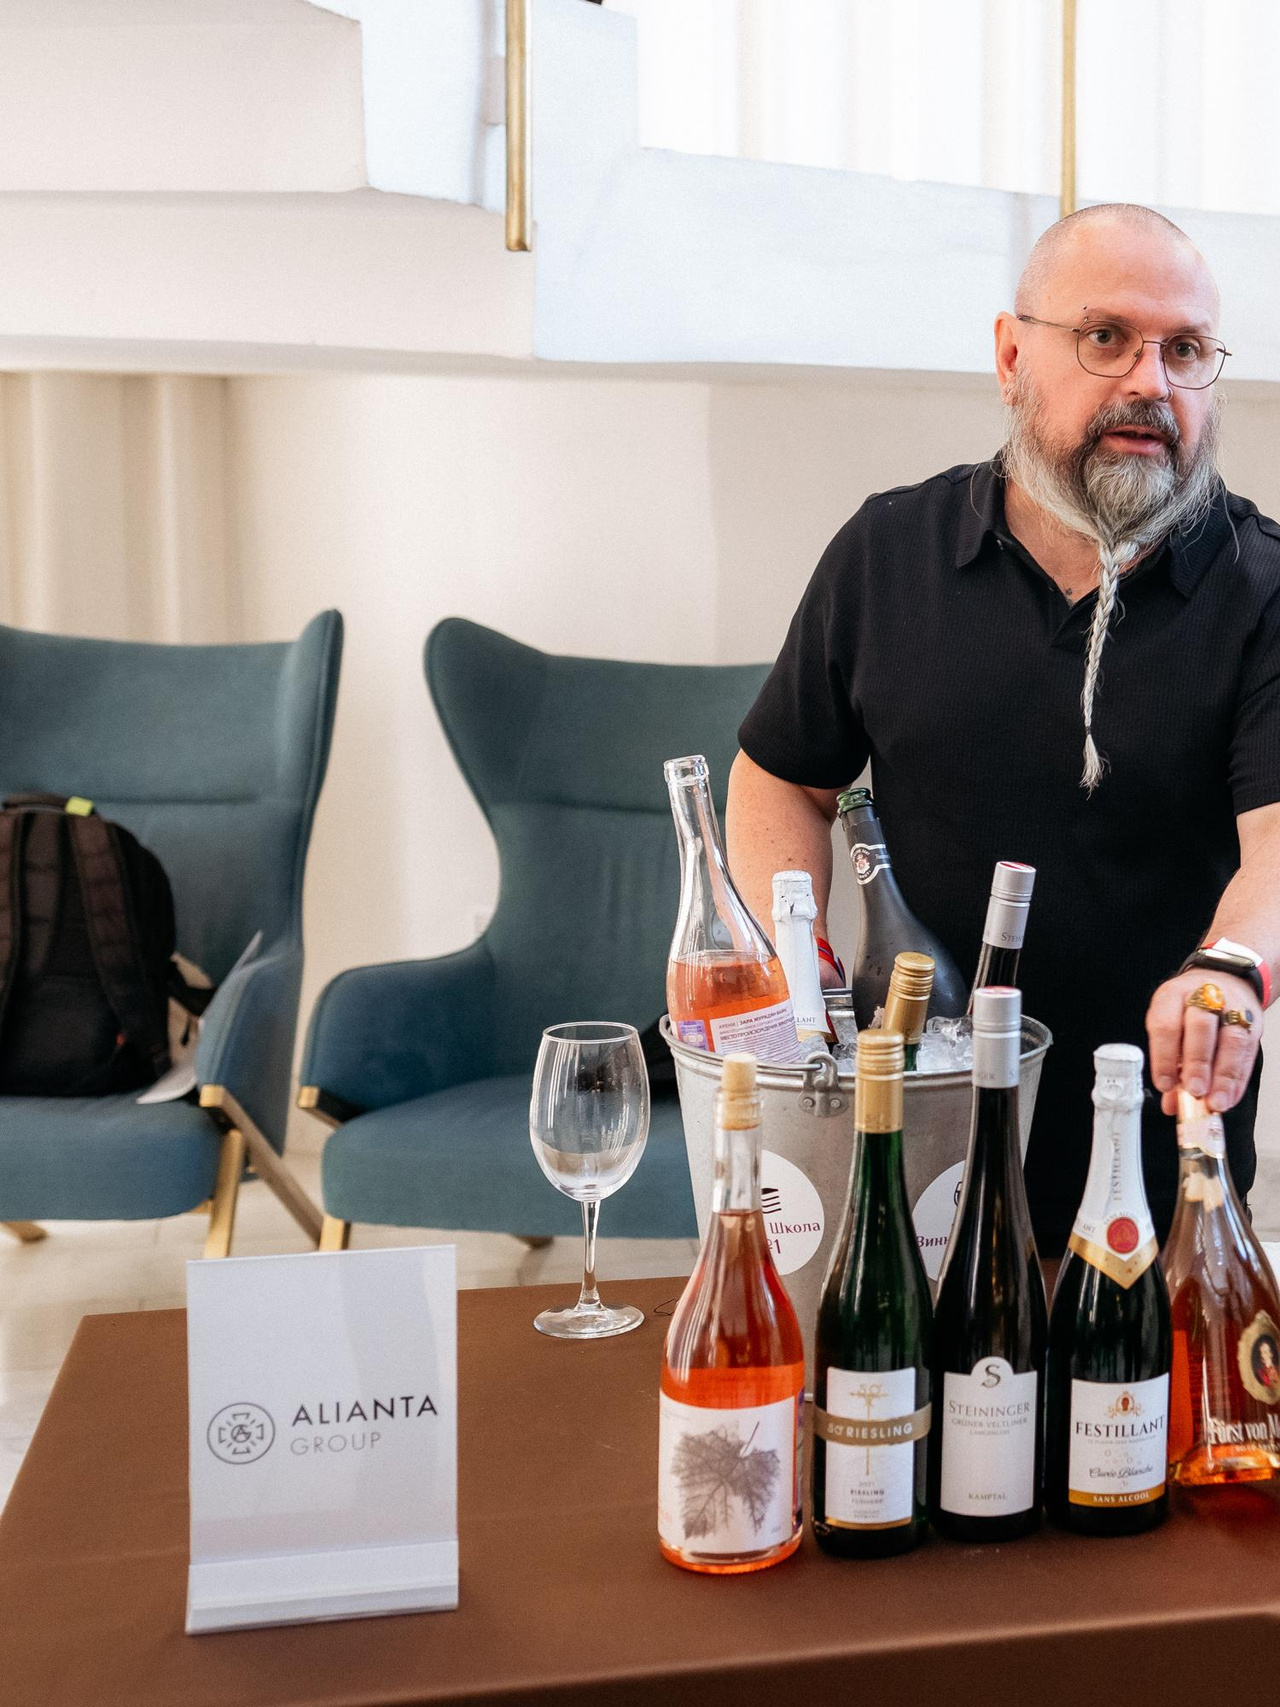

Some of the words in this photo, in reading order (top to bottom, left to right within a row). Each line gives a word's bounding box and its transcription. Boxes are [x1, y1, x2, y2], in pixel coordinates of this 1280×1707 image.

[769, 1221, 821, 1235] Школа
[982, 1363, 1001, 1389] S
[291, 1394, 439, 1427] ALIANTA
[948, 1399, 1031, 1418] STEININGER
[846, 1422, 913, 1440] RIESLING
[1075, 1414, 1165, 1438] FESTILLANT
[1243, 1421, 1269, 1441] von
[289, 1431, 382, 1456] GROUP
[967, 1491, 1007, 1501] KAMPTAL
[1092, 1494, 1115, 1504] SANS
[1116, 1491, 1150, 1503] ALCOOL
